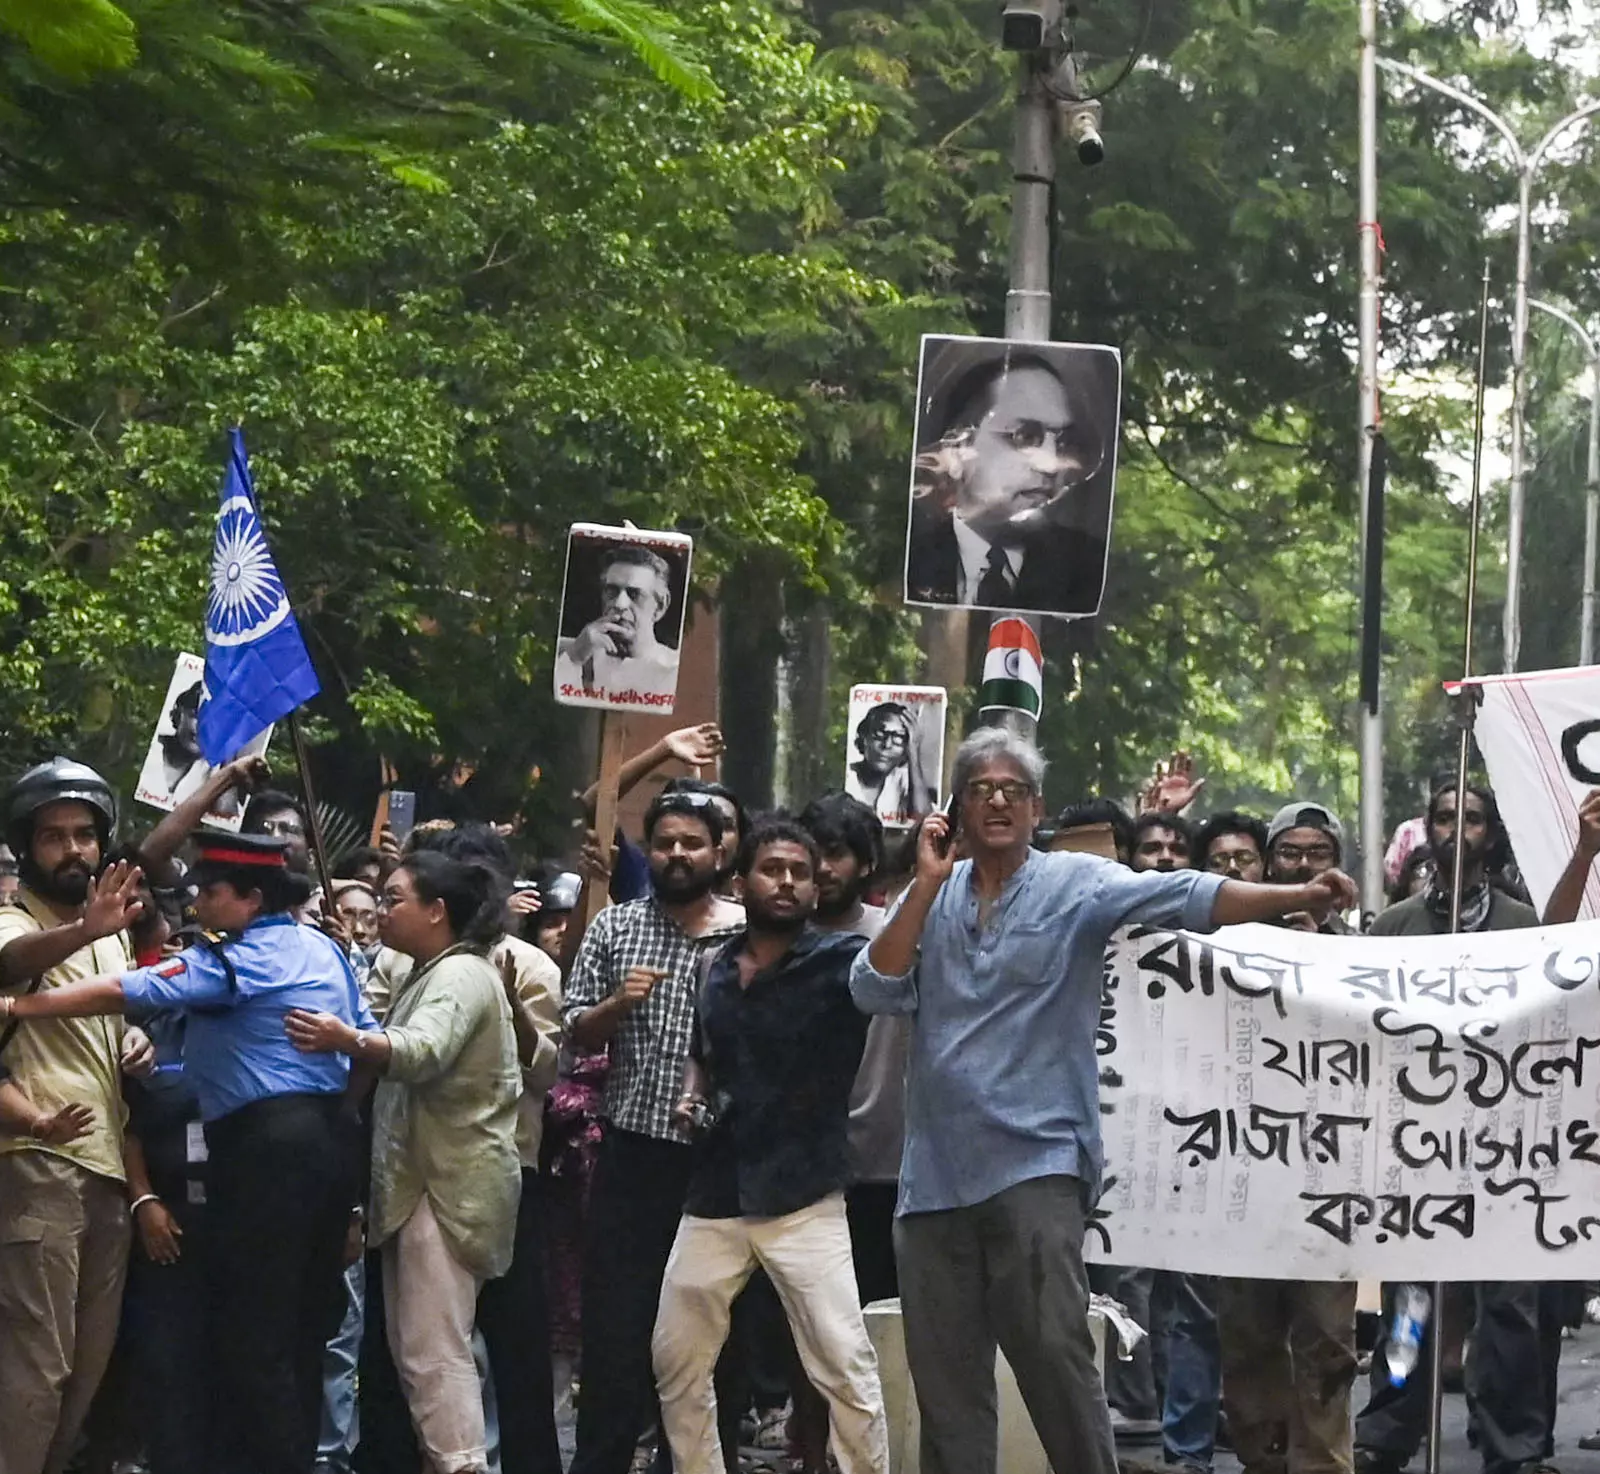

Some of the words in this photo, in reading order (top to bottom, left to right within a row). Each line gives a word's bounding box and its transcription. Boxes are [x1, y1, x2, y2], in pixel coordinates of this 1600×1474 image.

[1131, 925, 1307, 1020] রাজা
[1261, 1036, 1370, 1091] যারা
[1164, 1103, 1372, 1168] রাজার
[1299, 1190, 1475, 1246] করবে
